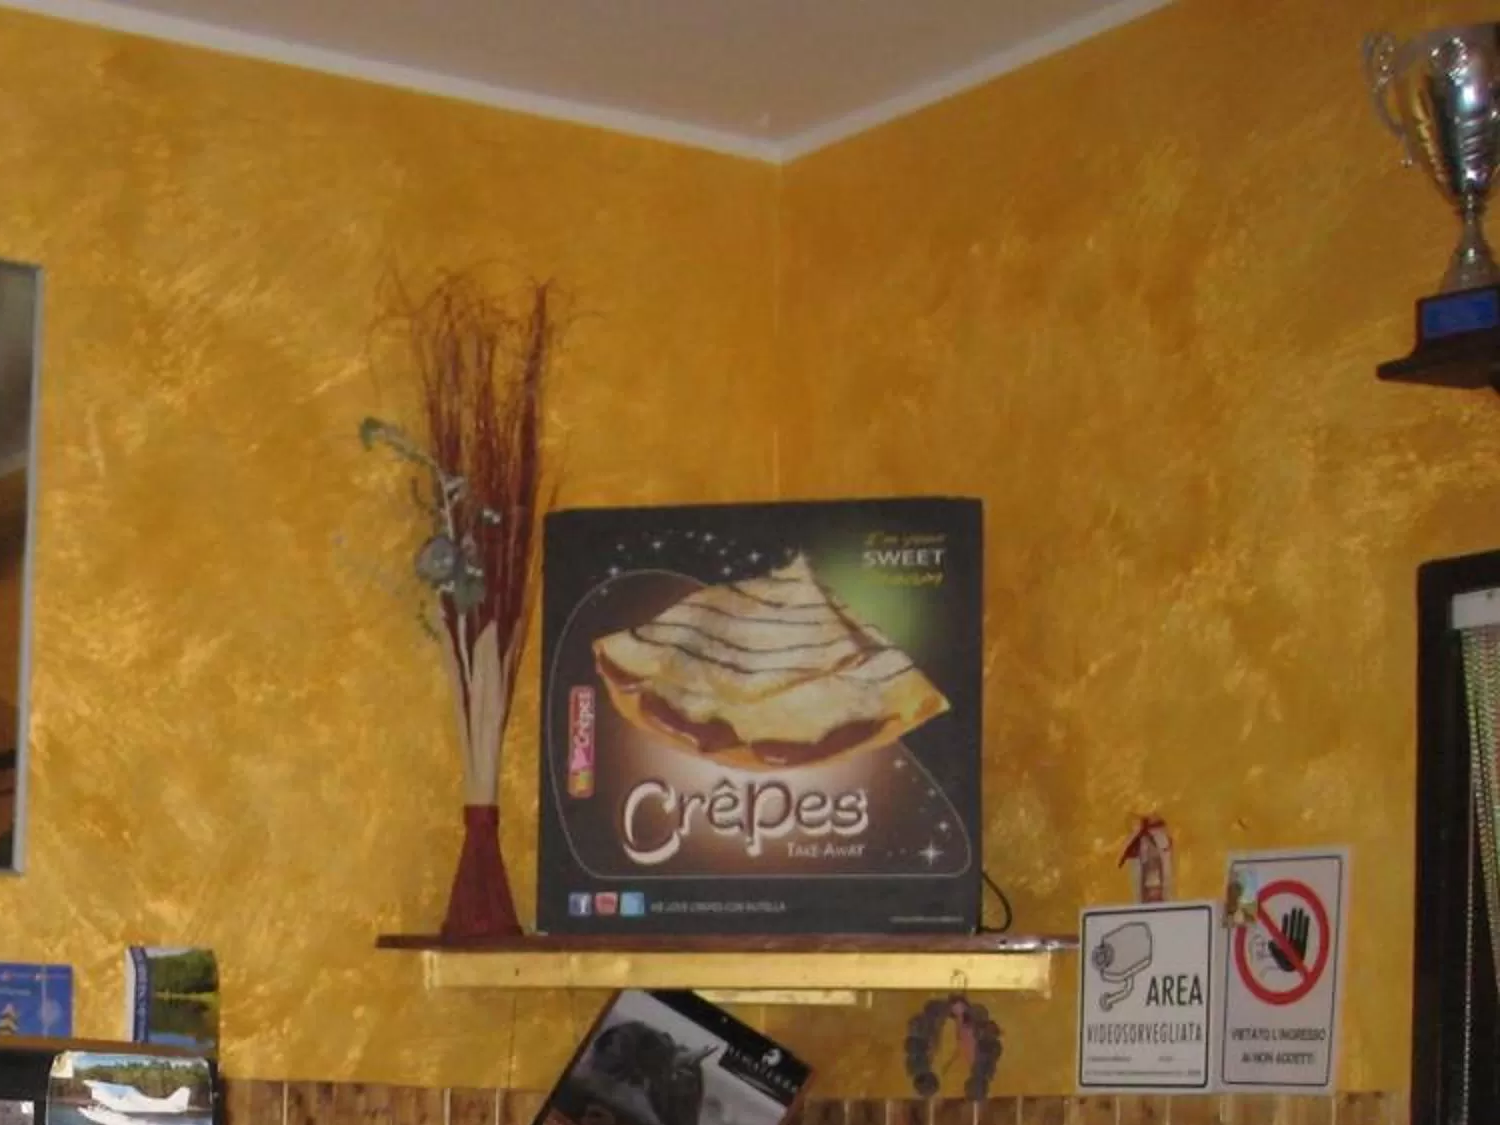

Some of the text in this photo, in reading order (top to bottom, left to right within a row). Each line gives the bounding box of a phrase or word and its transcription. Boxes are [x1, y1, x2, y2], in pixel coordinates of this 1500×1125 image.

[863, 548, 945, 567] SWEET
[622, 776, 869, 865] Crêpes
[1146, 974, 1203, 1007] AREA
